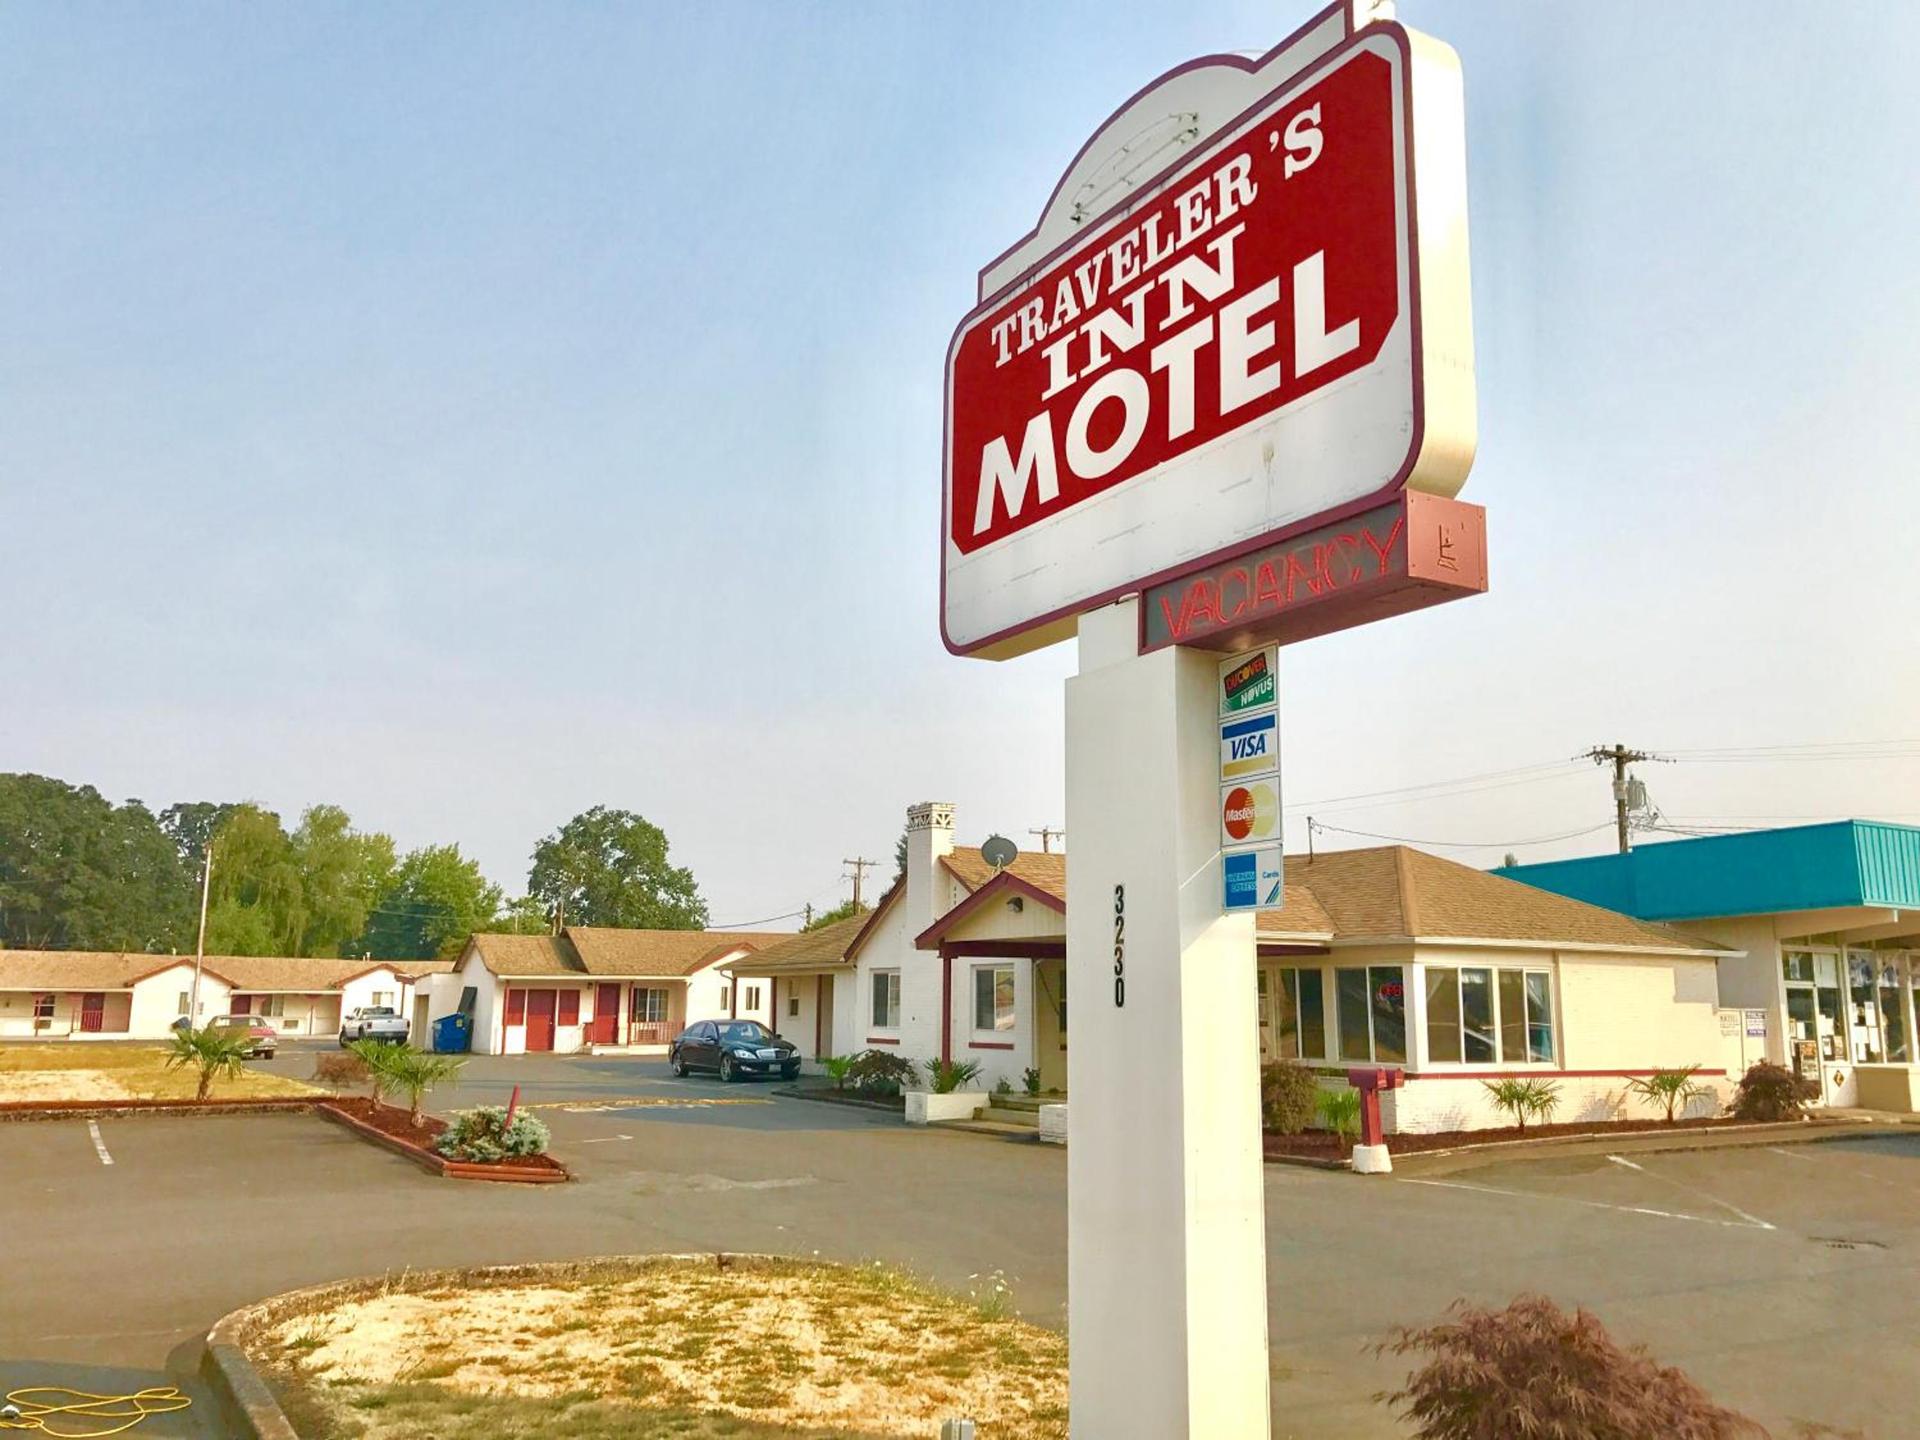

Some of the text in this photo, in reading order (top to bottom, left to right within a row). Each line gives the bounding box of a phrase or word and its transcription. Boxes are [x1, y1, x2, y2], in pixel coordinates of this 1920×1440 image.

[1041, 221, 1245, 402] INN
[973, 249, 1360, 537] MOTEL
[1159, 517, 1404, 638] VACANCY
[1231, 733, 1267, 761] VISA
[1114, 884, 1125, 1009] 3230
